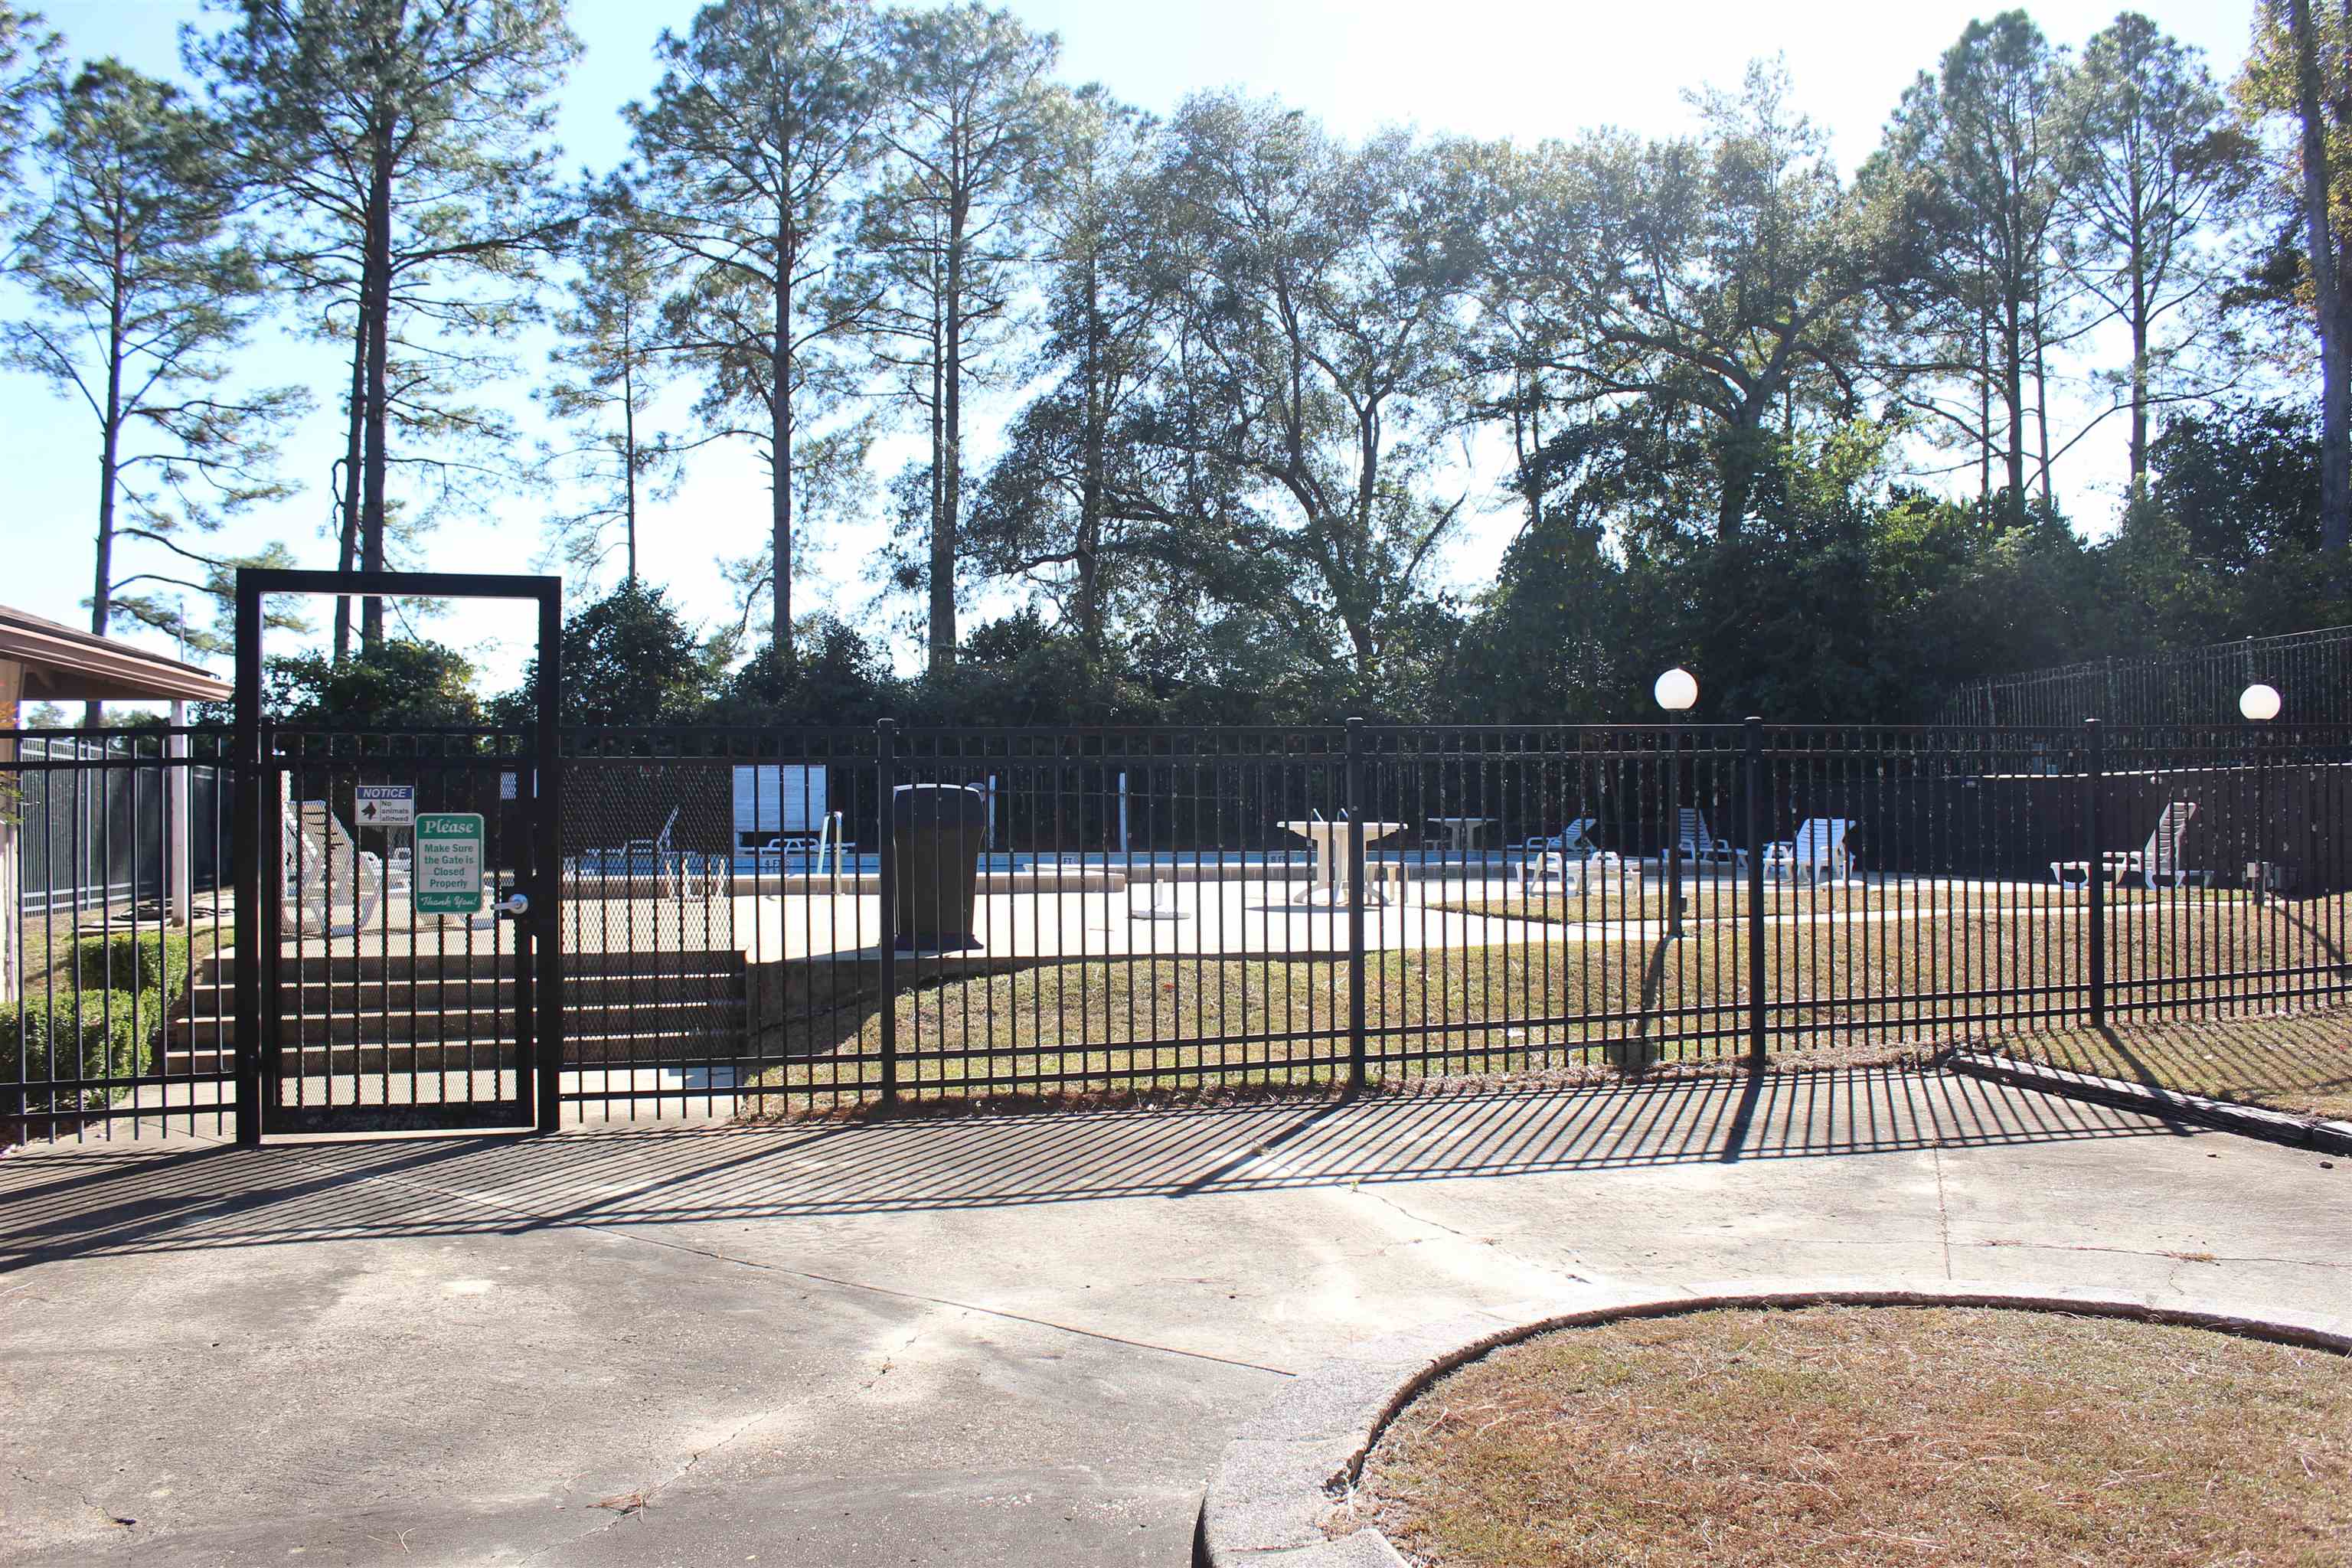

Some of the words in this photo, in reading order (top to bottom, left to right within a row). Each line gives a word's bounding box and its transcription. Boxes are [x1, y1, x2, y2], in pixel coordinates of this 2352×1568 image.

[363, 788, 407, 798] NOTICE
[423, 818, 474, 834] Please
[424, 844, 450, 852] Make
[452, 844, 473, 852] Sure
[424, 855, 439, 864] the
[442, 855, 463, 864] Gate
[466, 855, 474, 864] is
[433, 867, 465, 876] Closed
[430, 879, 468, 889] Properly
[421, 897, 452, 906] Thank
[453, 896, 478, 907] You!
